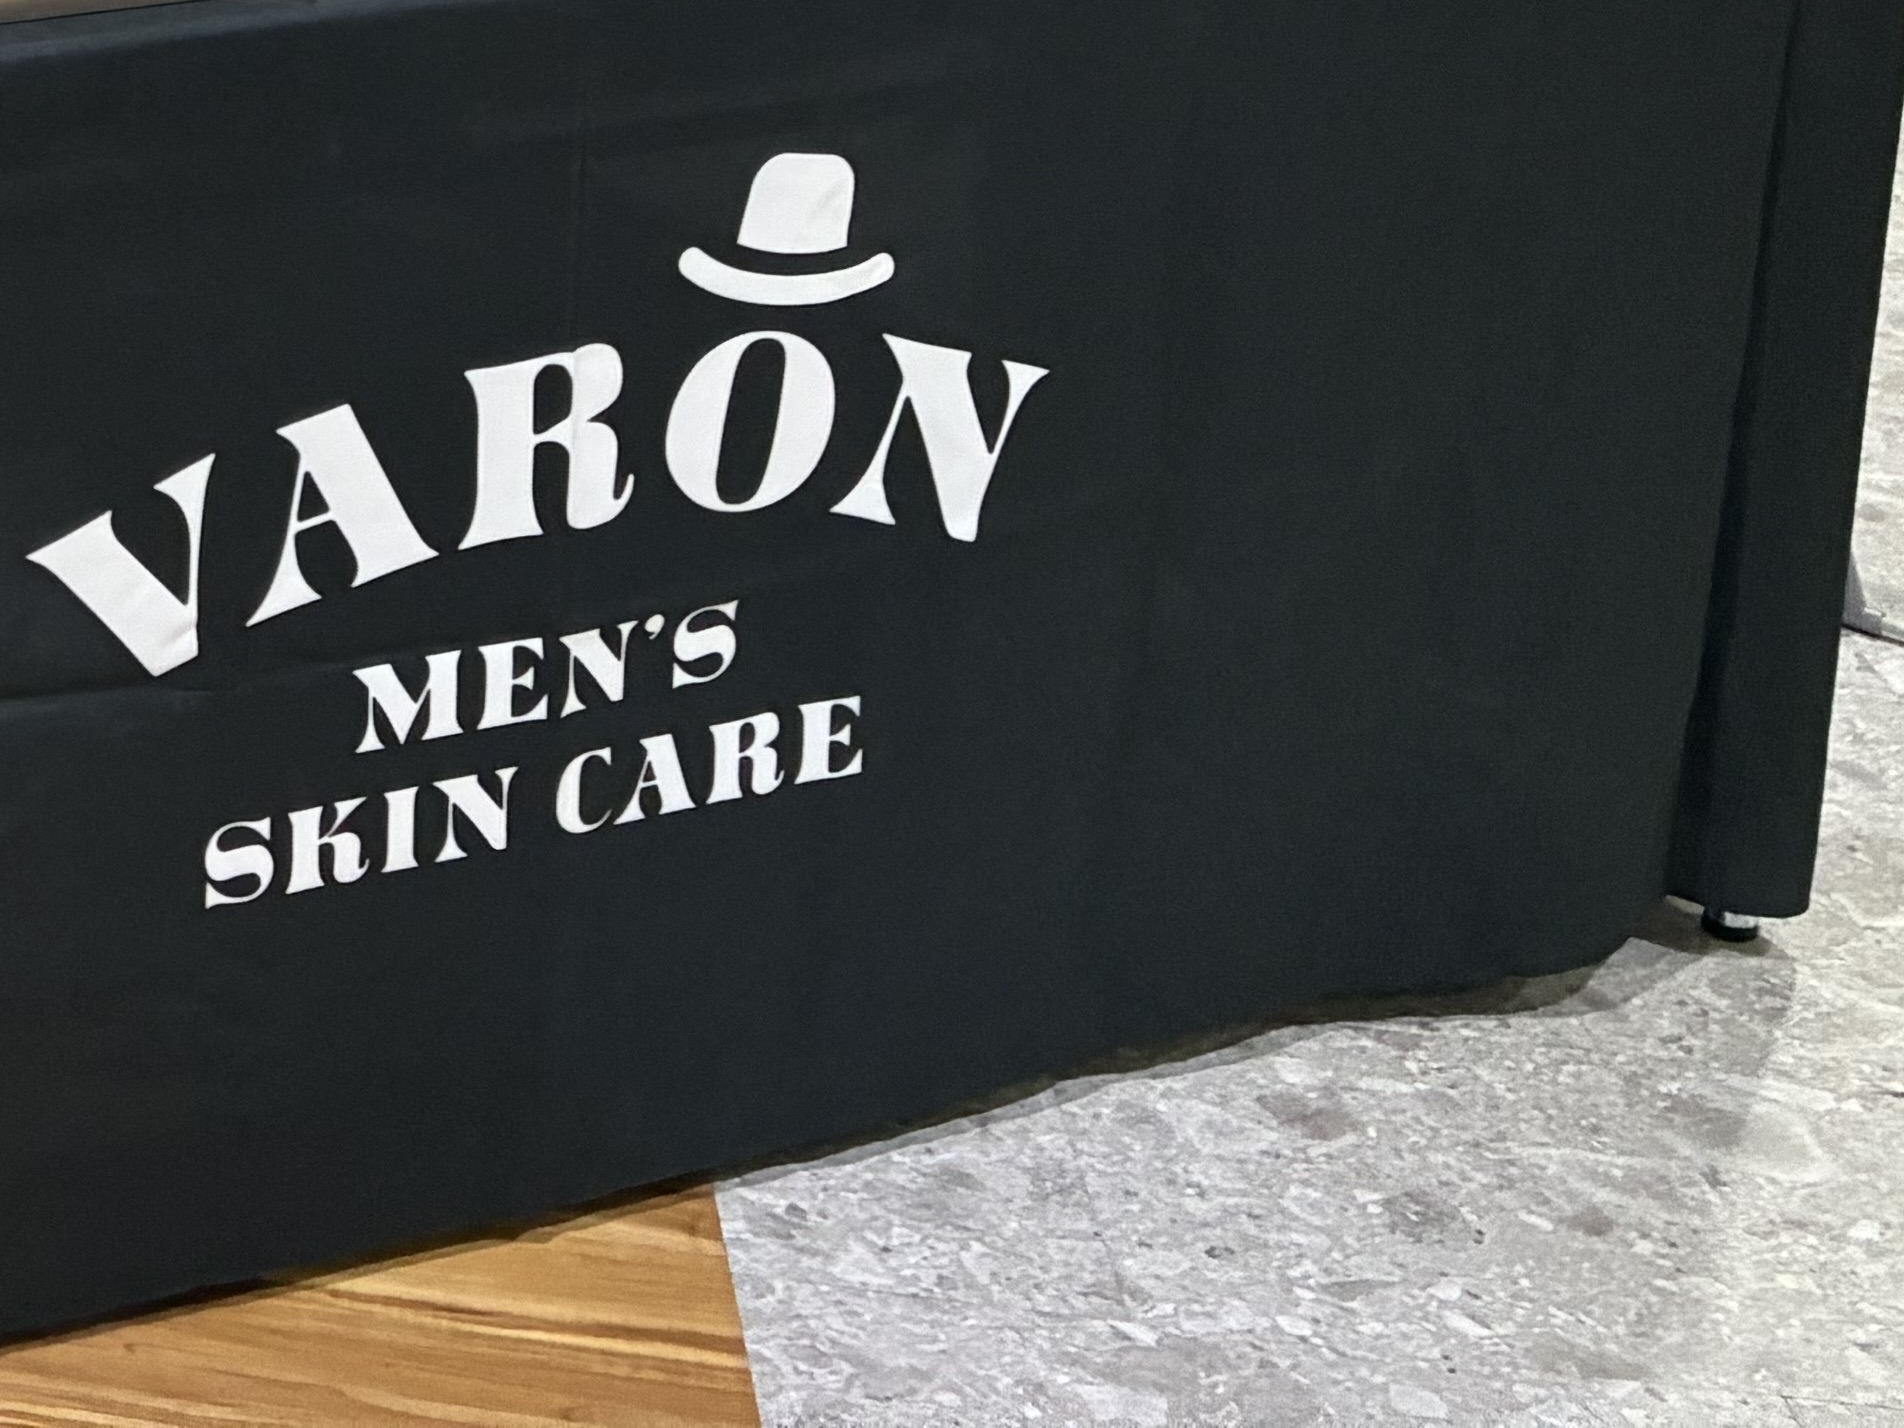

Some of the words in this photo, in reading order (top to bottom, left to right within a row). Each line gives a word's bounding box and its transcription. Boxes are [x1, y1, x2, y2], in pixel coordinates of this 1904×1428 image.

[25, 329, 1050, 679] VARON
[351, 598, 741, 755] MEN'S
[203, 764, 520, 911] SKIN
[553, 693, 866, 836] CARE
